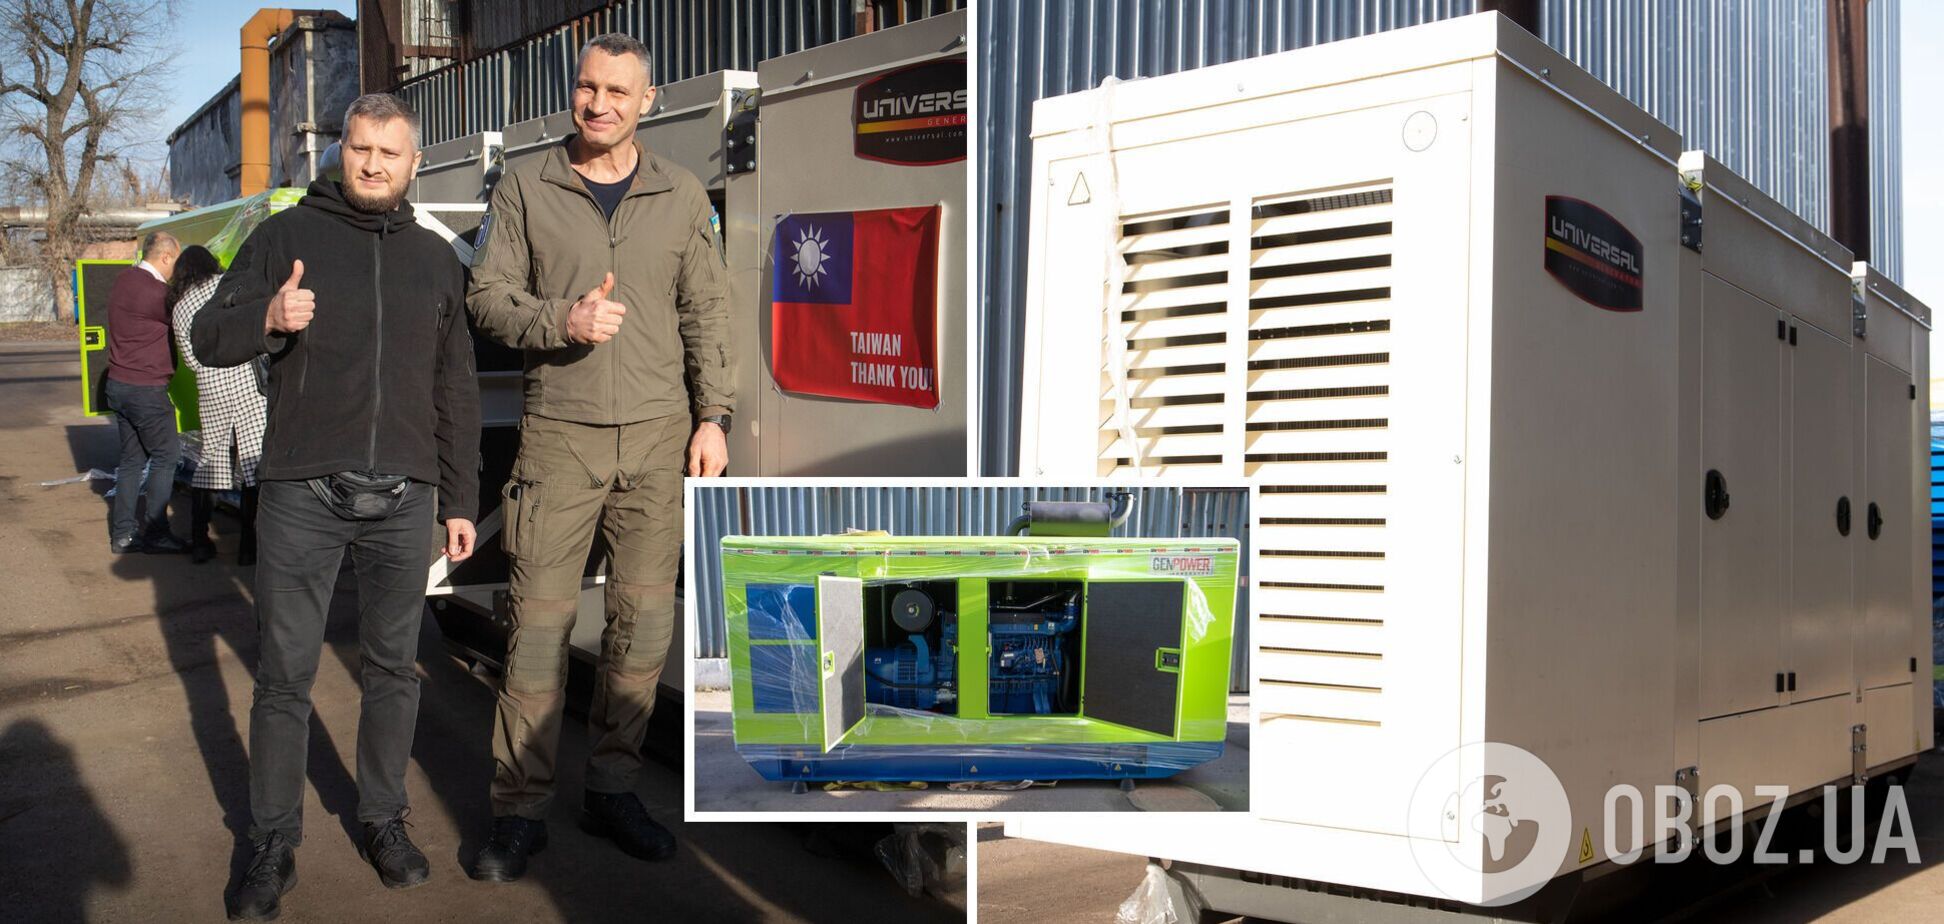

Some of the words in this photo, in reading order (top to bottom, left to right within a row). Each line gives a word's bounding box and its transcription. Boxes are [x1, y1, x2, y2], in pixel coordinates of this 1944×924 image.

[1552, 215, 1640, 274] UNIVERSAL
[850, 331, 902, 357] TAIWAN
[850, 362, 896, 387] THANK
[900, 367, 933, 391] YOU!
[1152, 557, 1211, 571] GENPOWER
